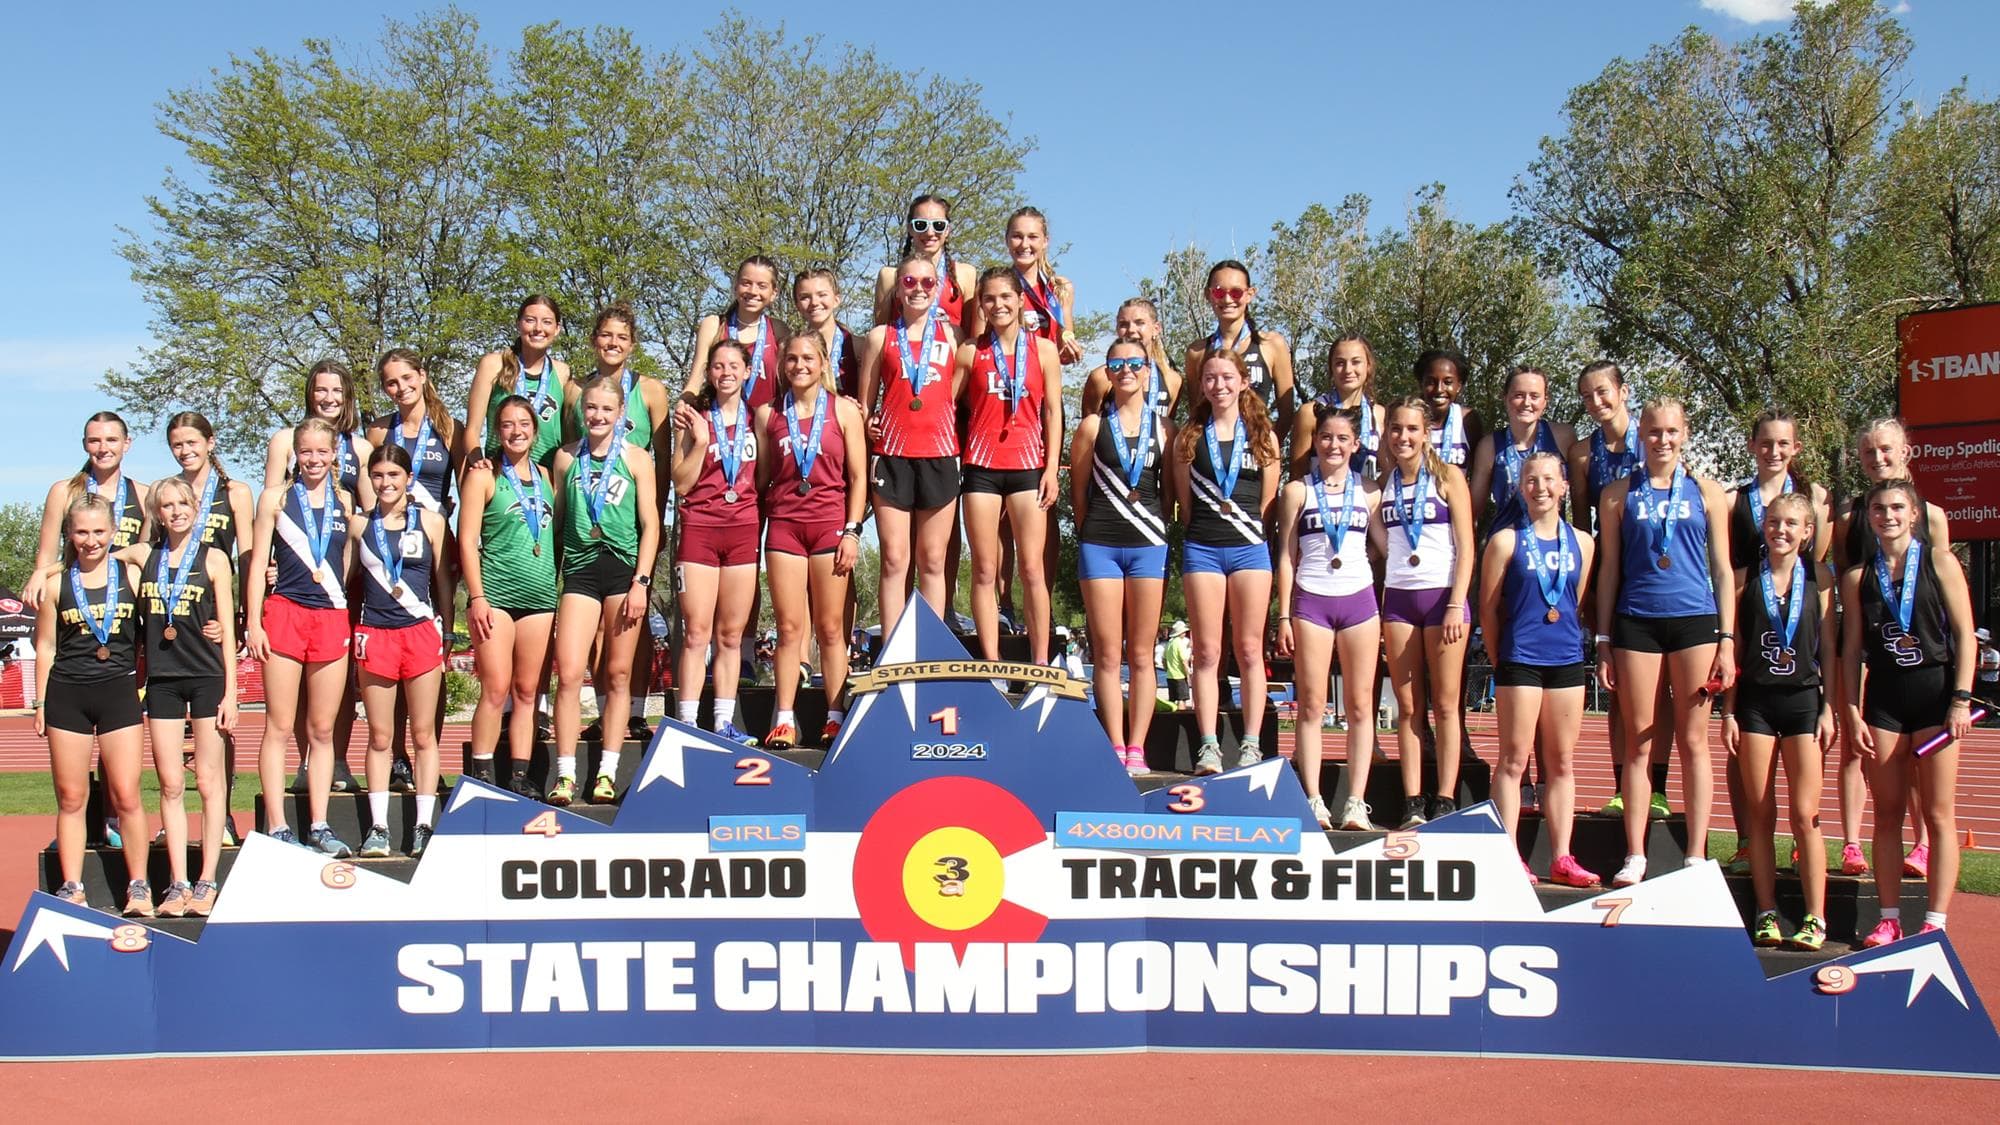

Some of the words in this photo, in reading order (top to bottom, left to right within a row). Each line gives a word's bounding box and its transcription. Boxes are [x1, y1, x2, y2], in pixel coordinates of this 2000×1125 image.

[935, 343, 942, 363] 1
[1924, 444, 1954, 459] Prep
[608, 479, 622, 501] 4
[2, 625, 30, 633] Locally
[877, 663, 942, 679] STATE
[948, 662, 1061, 680] CHAMPION
[929, 706, 959, 736] 1
[912, 743, 986, 759] 2024
[734, 757, 772, 786] 2
[1166, 784, 1205, 813] 3
[521, 810, 563, 838] 4
[711, 824, 801, 843] GIRLS
[1067, 822, 1183, 841] 4X800M
[1192, 825, 1294, 844] RELAY
[1382, 831, 1421, 860] 5
[320, 862, 357, 889] 6
[501, 858, 806, 900] COLORADO
[933, 856, 970, 883] 3
[1062, 858, 1266, 900] TRACK
[1271, 858, 1309, 901] &
[1322, 859, 1476, 902] FIELD
[1594, 897, 1632, 927] 7
[108, 924, 149, 954] 8
[398, 942, 696, 1014] STATE
[713, 941, 1558, 1018] CHAMPIONSHIPS
[1814, 965, 1858, 996] 9
